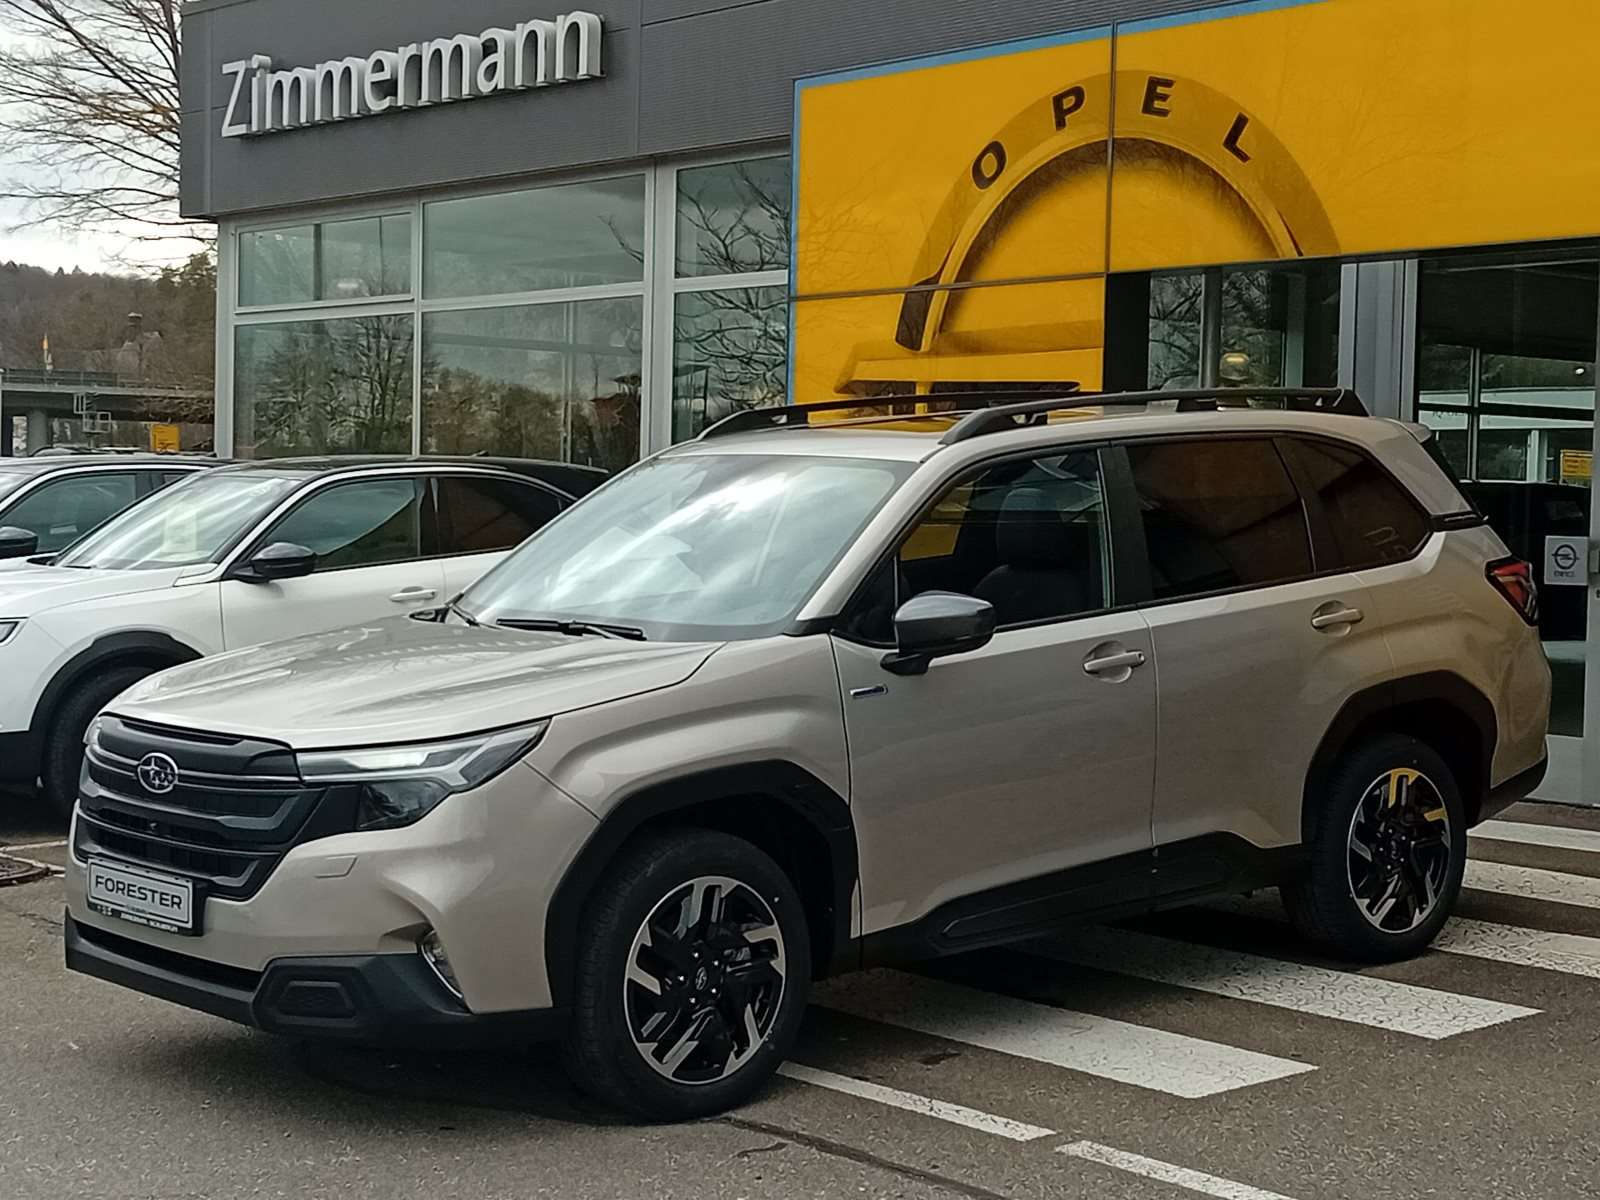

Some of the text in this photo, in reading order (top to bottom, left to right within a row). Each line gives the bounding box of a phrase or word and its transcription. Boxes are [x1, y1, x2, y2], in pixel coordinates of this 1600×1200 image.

[221, 10, 606, 138] Zimmermann
[971, 75, 1251, 191] OPEL
[95, 875, 182, 910] FORESTER
